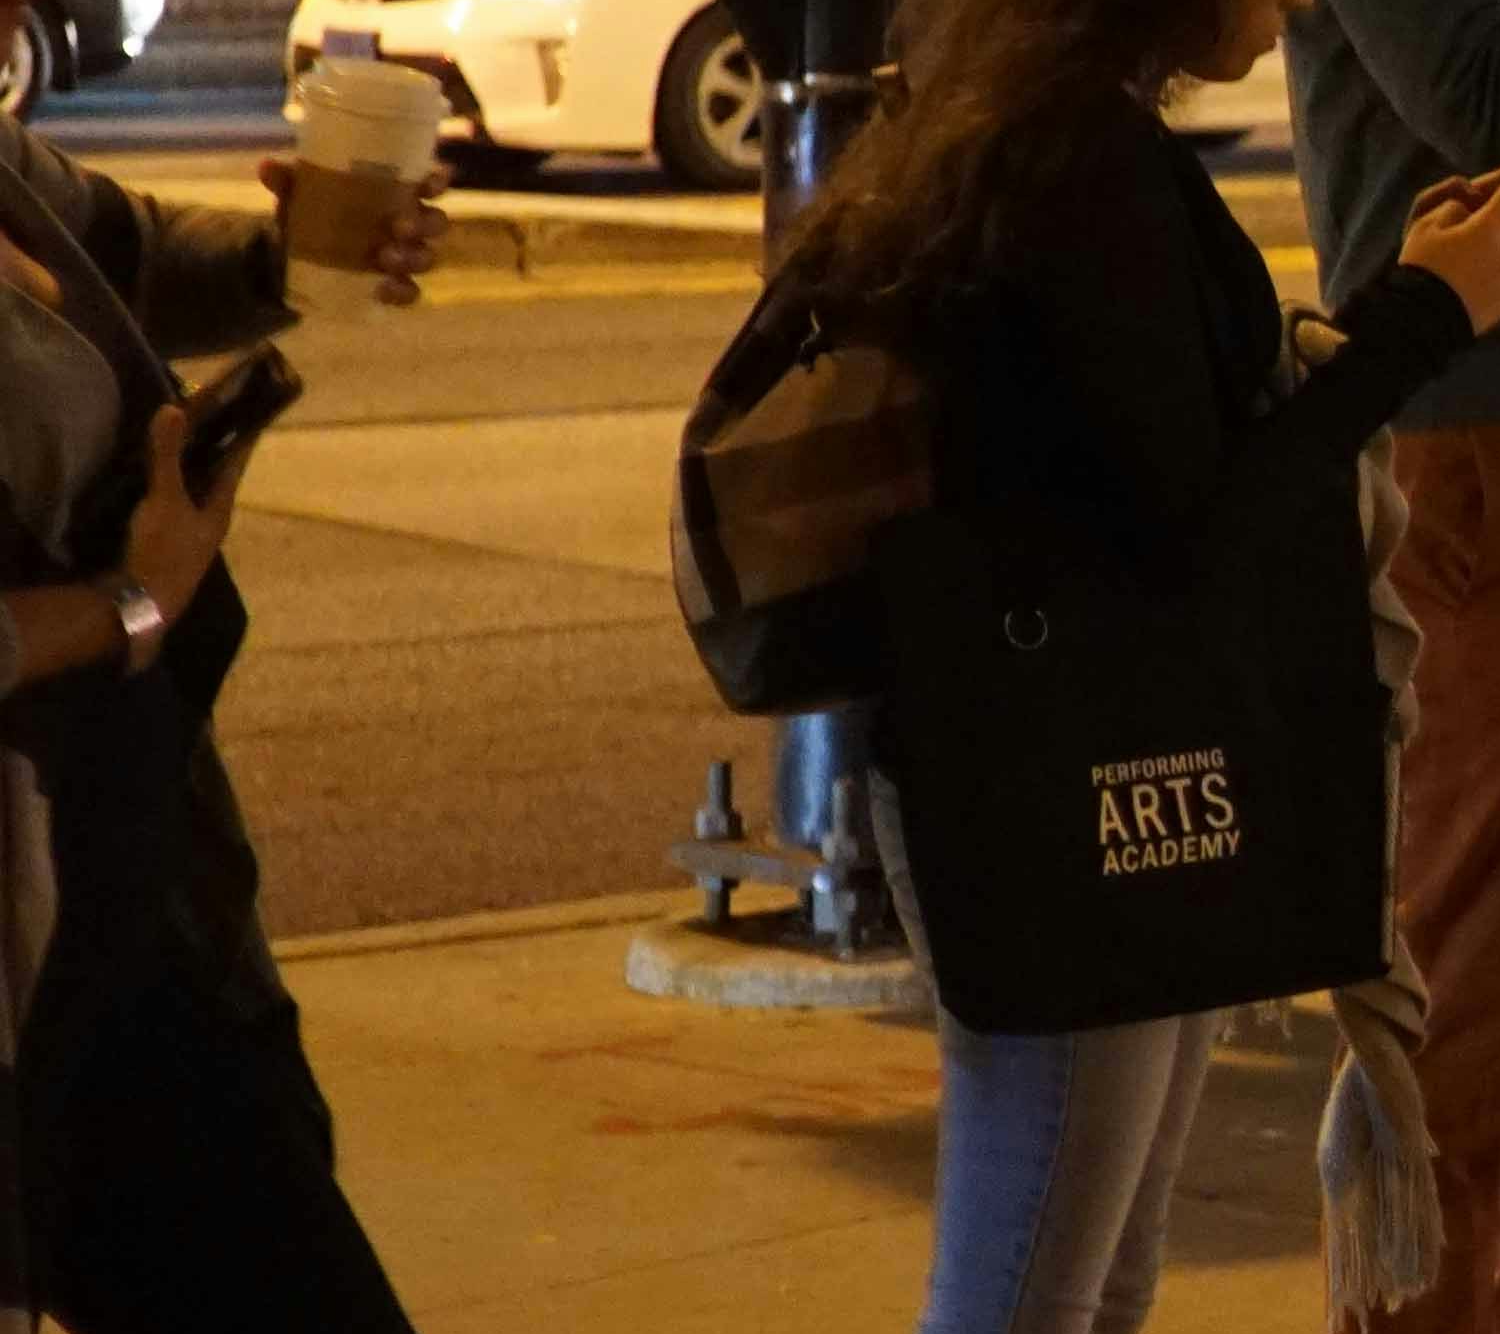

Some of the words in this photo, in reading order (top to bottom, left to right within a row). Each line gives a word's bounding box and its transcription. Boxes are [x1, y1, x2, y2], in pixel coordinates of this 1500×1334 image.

[1091, 748, 1225, 786] PERFORMING
[1100, 772, 1234, 845] ARTS
[1103, 828, 1240, 876] ACADEMY
